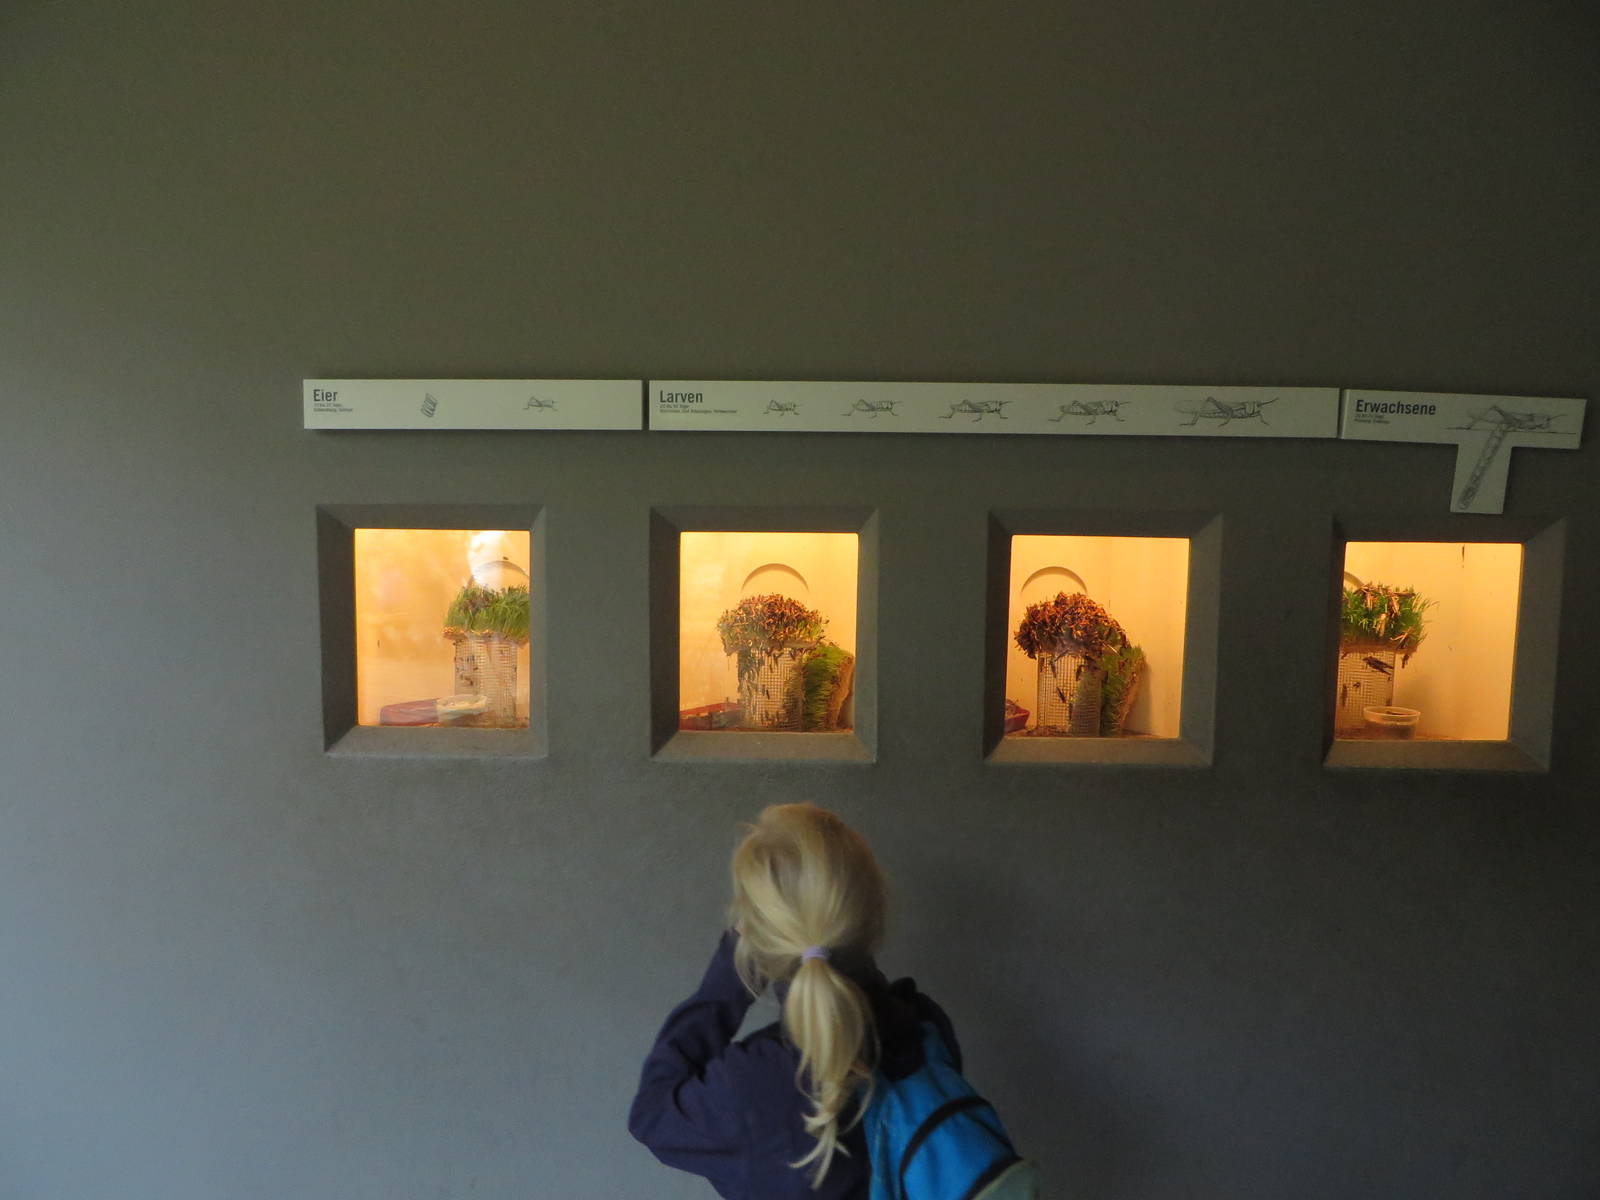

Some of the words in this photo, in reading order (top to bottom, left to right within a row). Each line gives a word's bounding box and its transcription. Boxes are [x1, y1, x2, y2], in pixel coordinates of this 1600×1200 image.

[313, 389, 338, 402] Eier
[660, 390, 703, 403] Larven
[1356, 399, 1436, 415] Erwachsene
